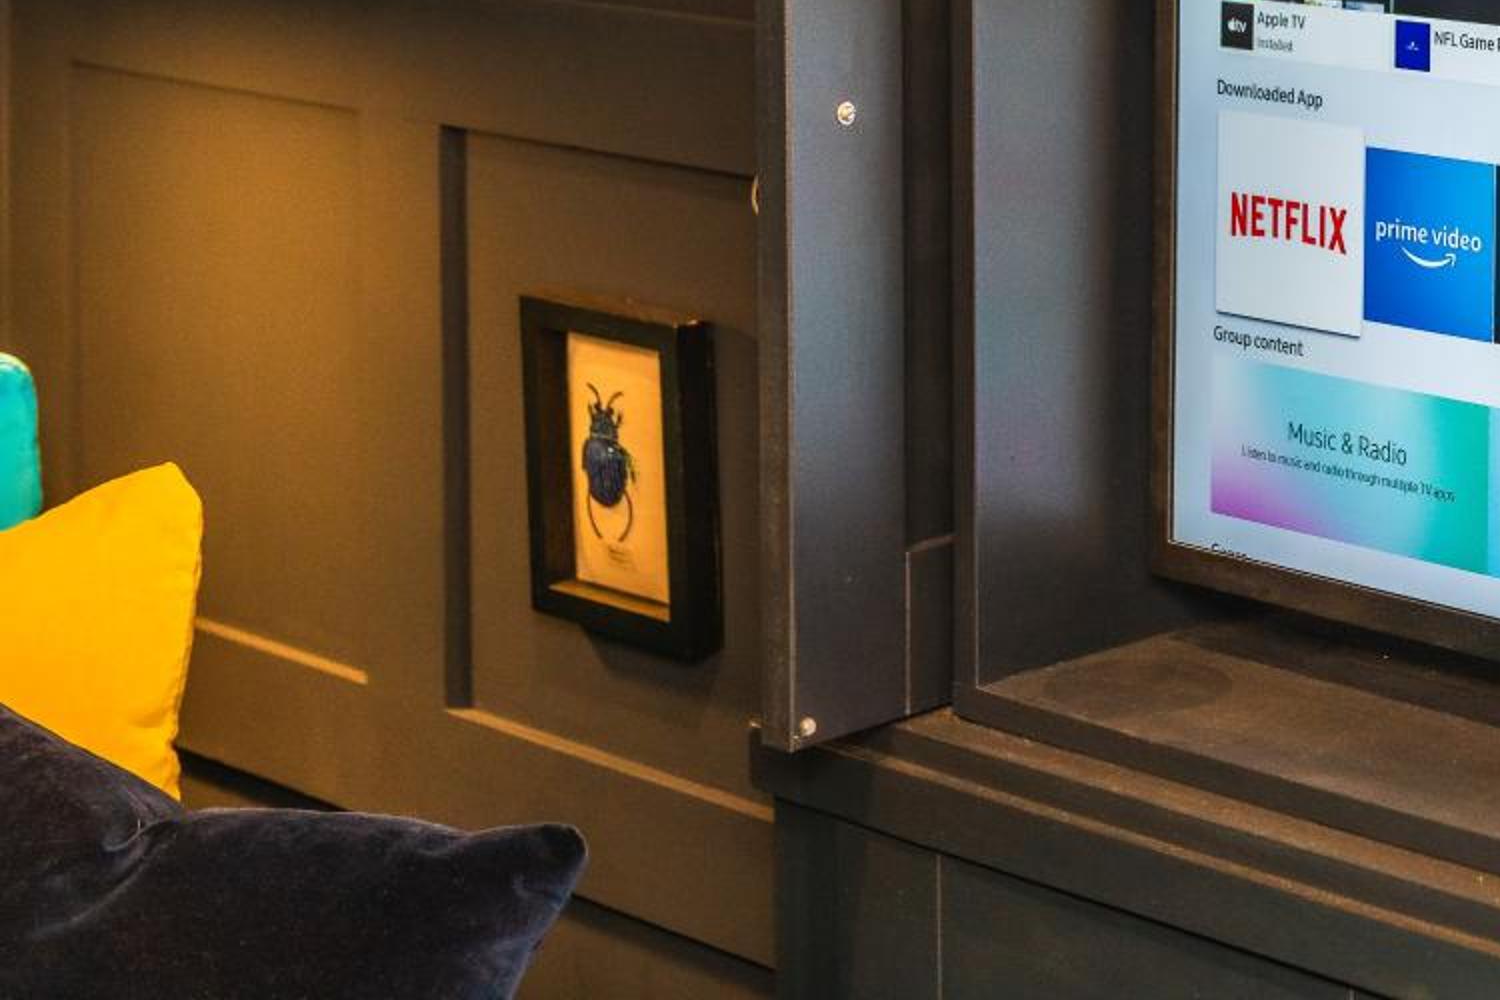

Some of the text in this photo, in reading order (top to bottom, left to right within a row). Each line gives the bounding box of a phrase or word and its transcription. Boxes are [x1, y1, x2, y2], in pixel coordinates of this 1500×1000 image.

[1257, 11, 1306, 29] Apple TV
[1257, 38, 1293, 51] Installed
[1434, 31, 1457, 47] NFL
[1460, 34, 1494, 51] Game
[1217, 79, 1323, 110] Downloaded App
[1231, 191, 1347, 255] NETFLIX
[1375, 218, 1482, 252] prime video
[1213, 325, 1304, 357] Group content
[1287, 421, 1407, 466] Music & Radio
[1267, 449, 1276, 463] to
[1277, 453, 1302, 469] music
[1304, 457, 1320, 472] and
[1321, 461, 1344, 478] radio
[1344, 464, 1381, 487] through
[1381, 474, 1418, 495] multiple
[1420, 481, 1432, 496] TV
[1433, 487, 1456, 503] apps
